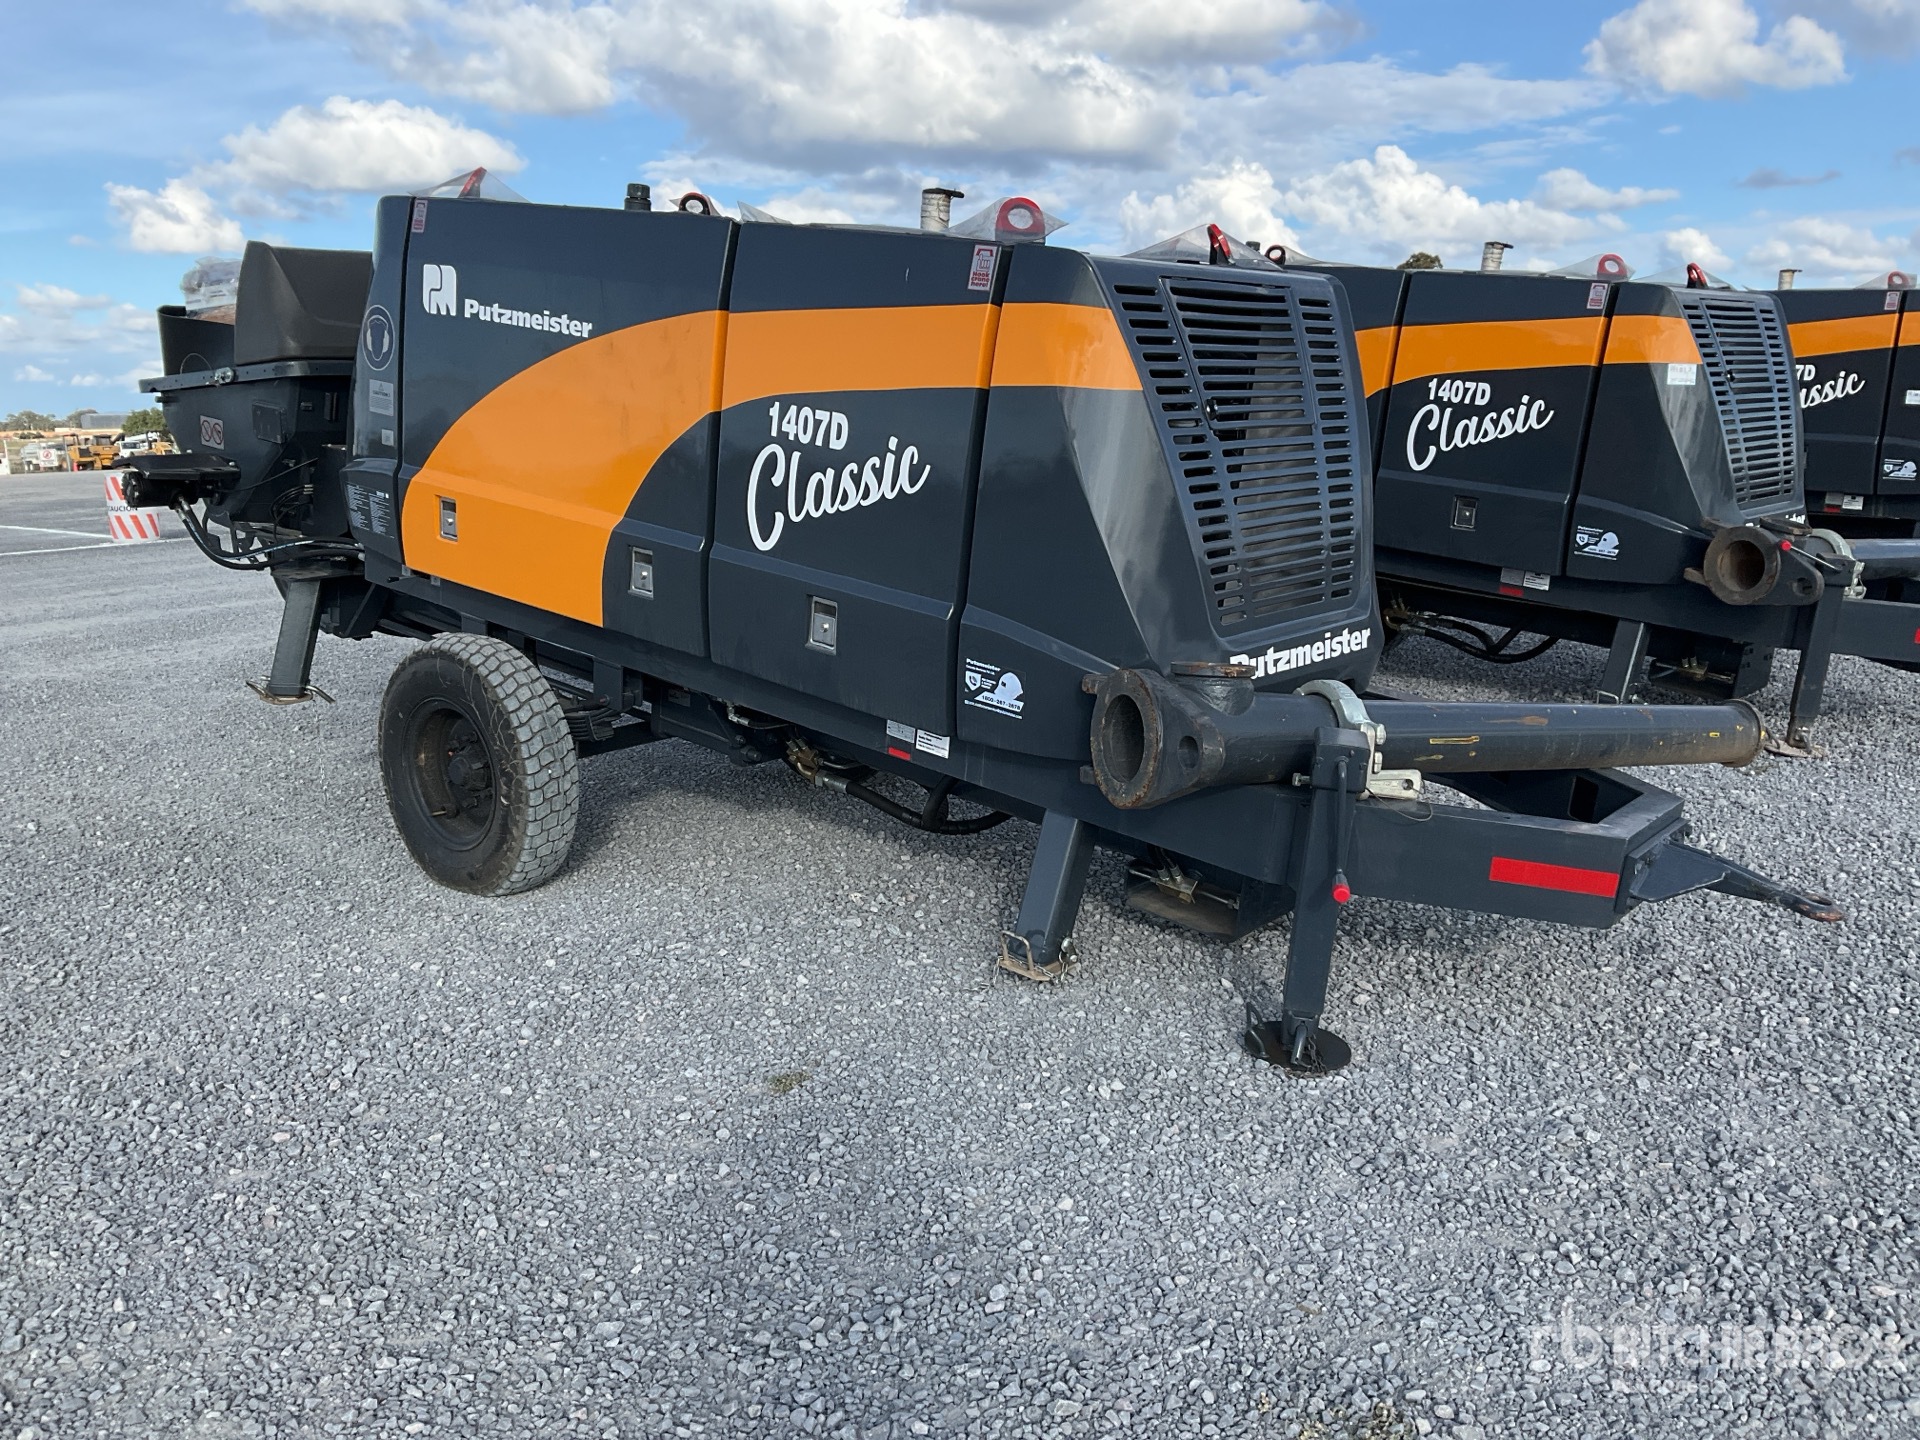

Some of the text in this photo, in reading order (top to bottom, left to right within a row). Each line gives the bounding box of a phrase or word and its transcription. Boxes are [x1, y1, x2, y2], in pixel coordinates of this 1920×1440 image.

[464, 299, 593, 338] Putzmeister
[1428, 378, 1491, 406] 1407D
[769, 401, 849, 450] 1407D
[1406, 403, 1554, 471] Classic
[747, 443, 931, 551] Classic
